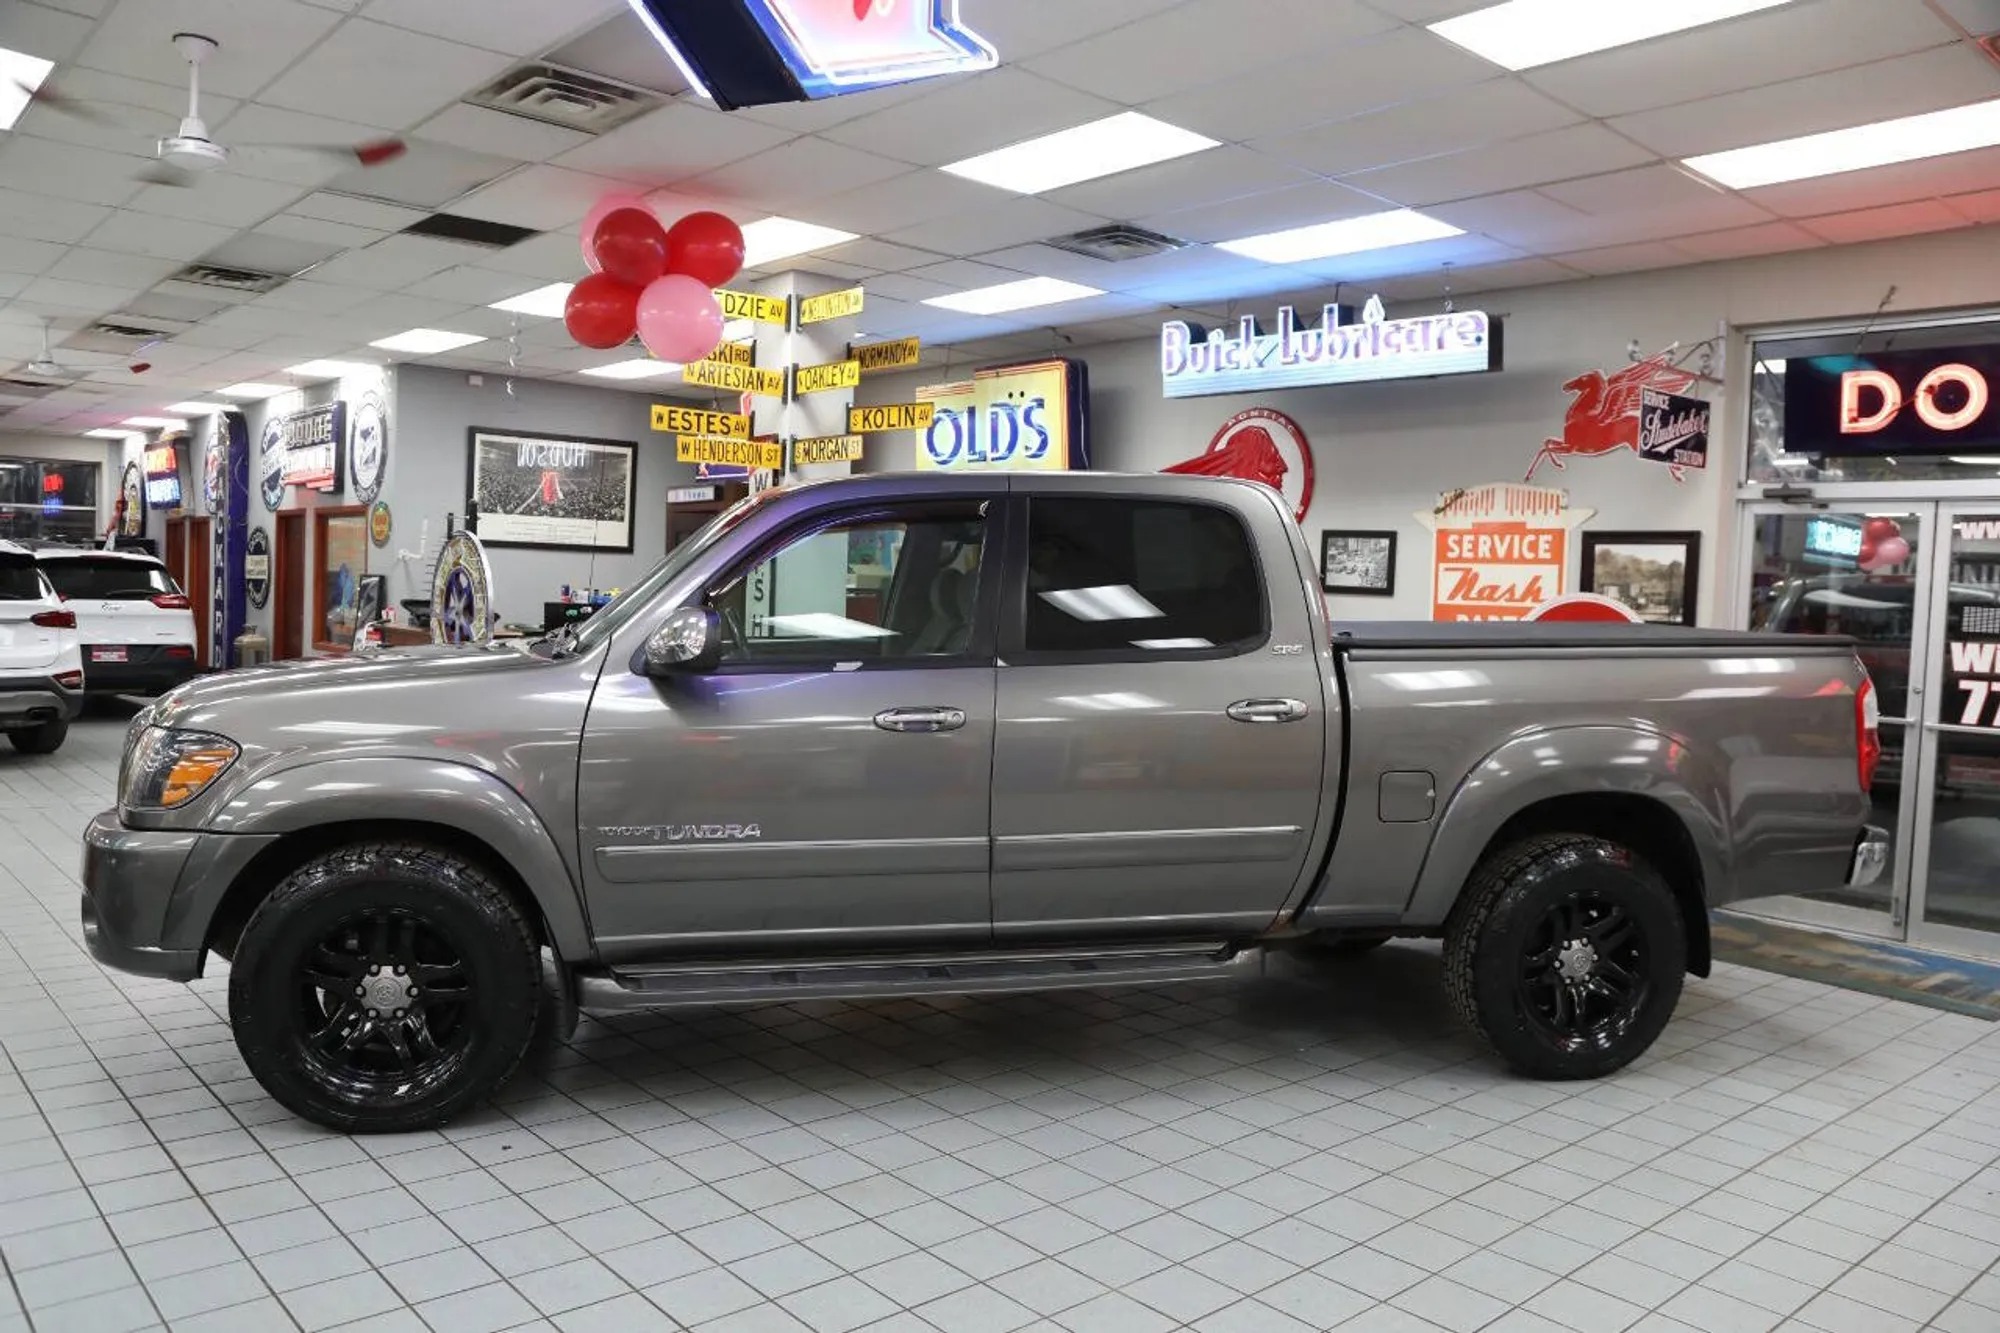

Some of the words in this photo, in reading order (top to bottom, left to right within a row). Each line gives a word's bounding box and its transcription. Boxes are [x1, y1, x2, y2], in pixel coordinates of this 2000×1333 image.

[714, 291, 766, 319] DZIE
[770, 304, 783, 317] AV
[704, 341, 733, 364] SKI
[735, 348, 750, 363] RD
[1163, 316, 1265, 375] Buick
[1280, 304, 1487, 362] Lubricare
[860, 341, 907, 368] NORMANDY
[697, 361, 764, 391] ARTESIAN
[767, 376, 779, 389] AV
[804, 364, 845, 391] OAKLEY
[656, 411, 664, 425] W
[667, 409, 731, 436] ESTES
[734, 420, 747, 433] AV
[852, 414, 858, 427] S
[862, 406, 916, 429] KOLIN
[918, 408, 929, 421] AV
[1227, 409, 1297, 434] PONTIAC
[681, 441, 691, 456] W
[693, 439, 763, 465] HENDERSON
[766, 448, 779, 462] ST
[803, 439, 848, 463] MORGAN
[850, 440, 859, 454] ST
[754, 471, 769, 491] W
[1446, 534, 1552, 560] SERVICE
[1443, 566, 1545, 603] Nash
[650, 824, 760, 840] TUNDRA
